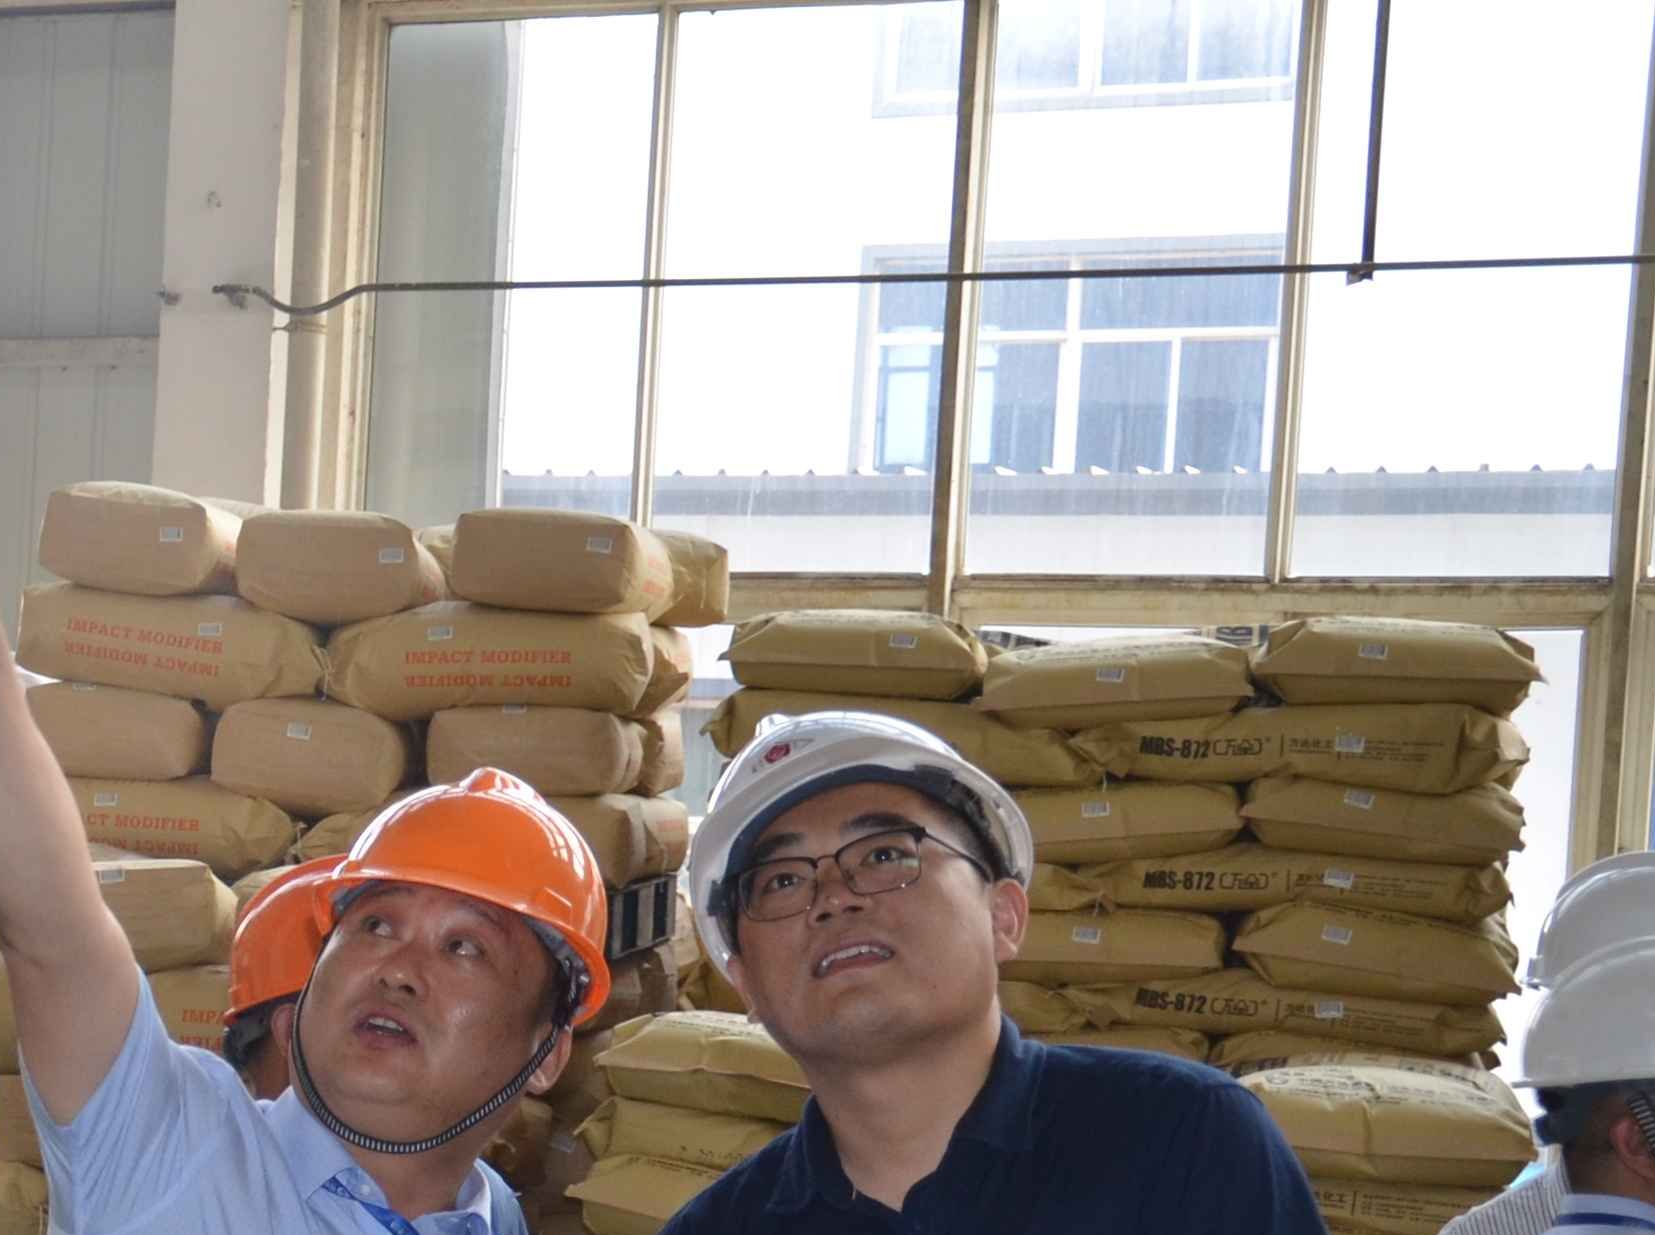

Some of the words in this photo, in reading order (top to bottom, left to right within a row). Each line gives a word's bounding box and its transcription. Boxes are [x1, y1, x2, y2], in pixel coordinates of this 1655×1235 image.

[65, 617, 133, 639] IMPACT
[137, 630, 224, 654] MODIFIER
[406, 651, 473, 664] IMPACT
[480, 651, 571, 664] MODIFIER
[1139, 736, 1210, 759] MBS-872
[115, 815, 200, 832] MODIFIER
[1143, 870, 1215, 890] MBS-872
[1137, 987, 1208, 1015] MBS-872
